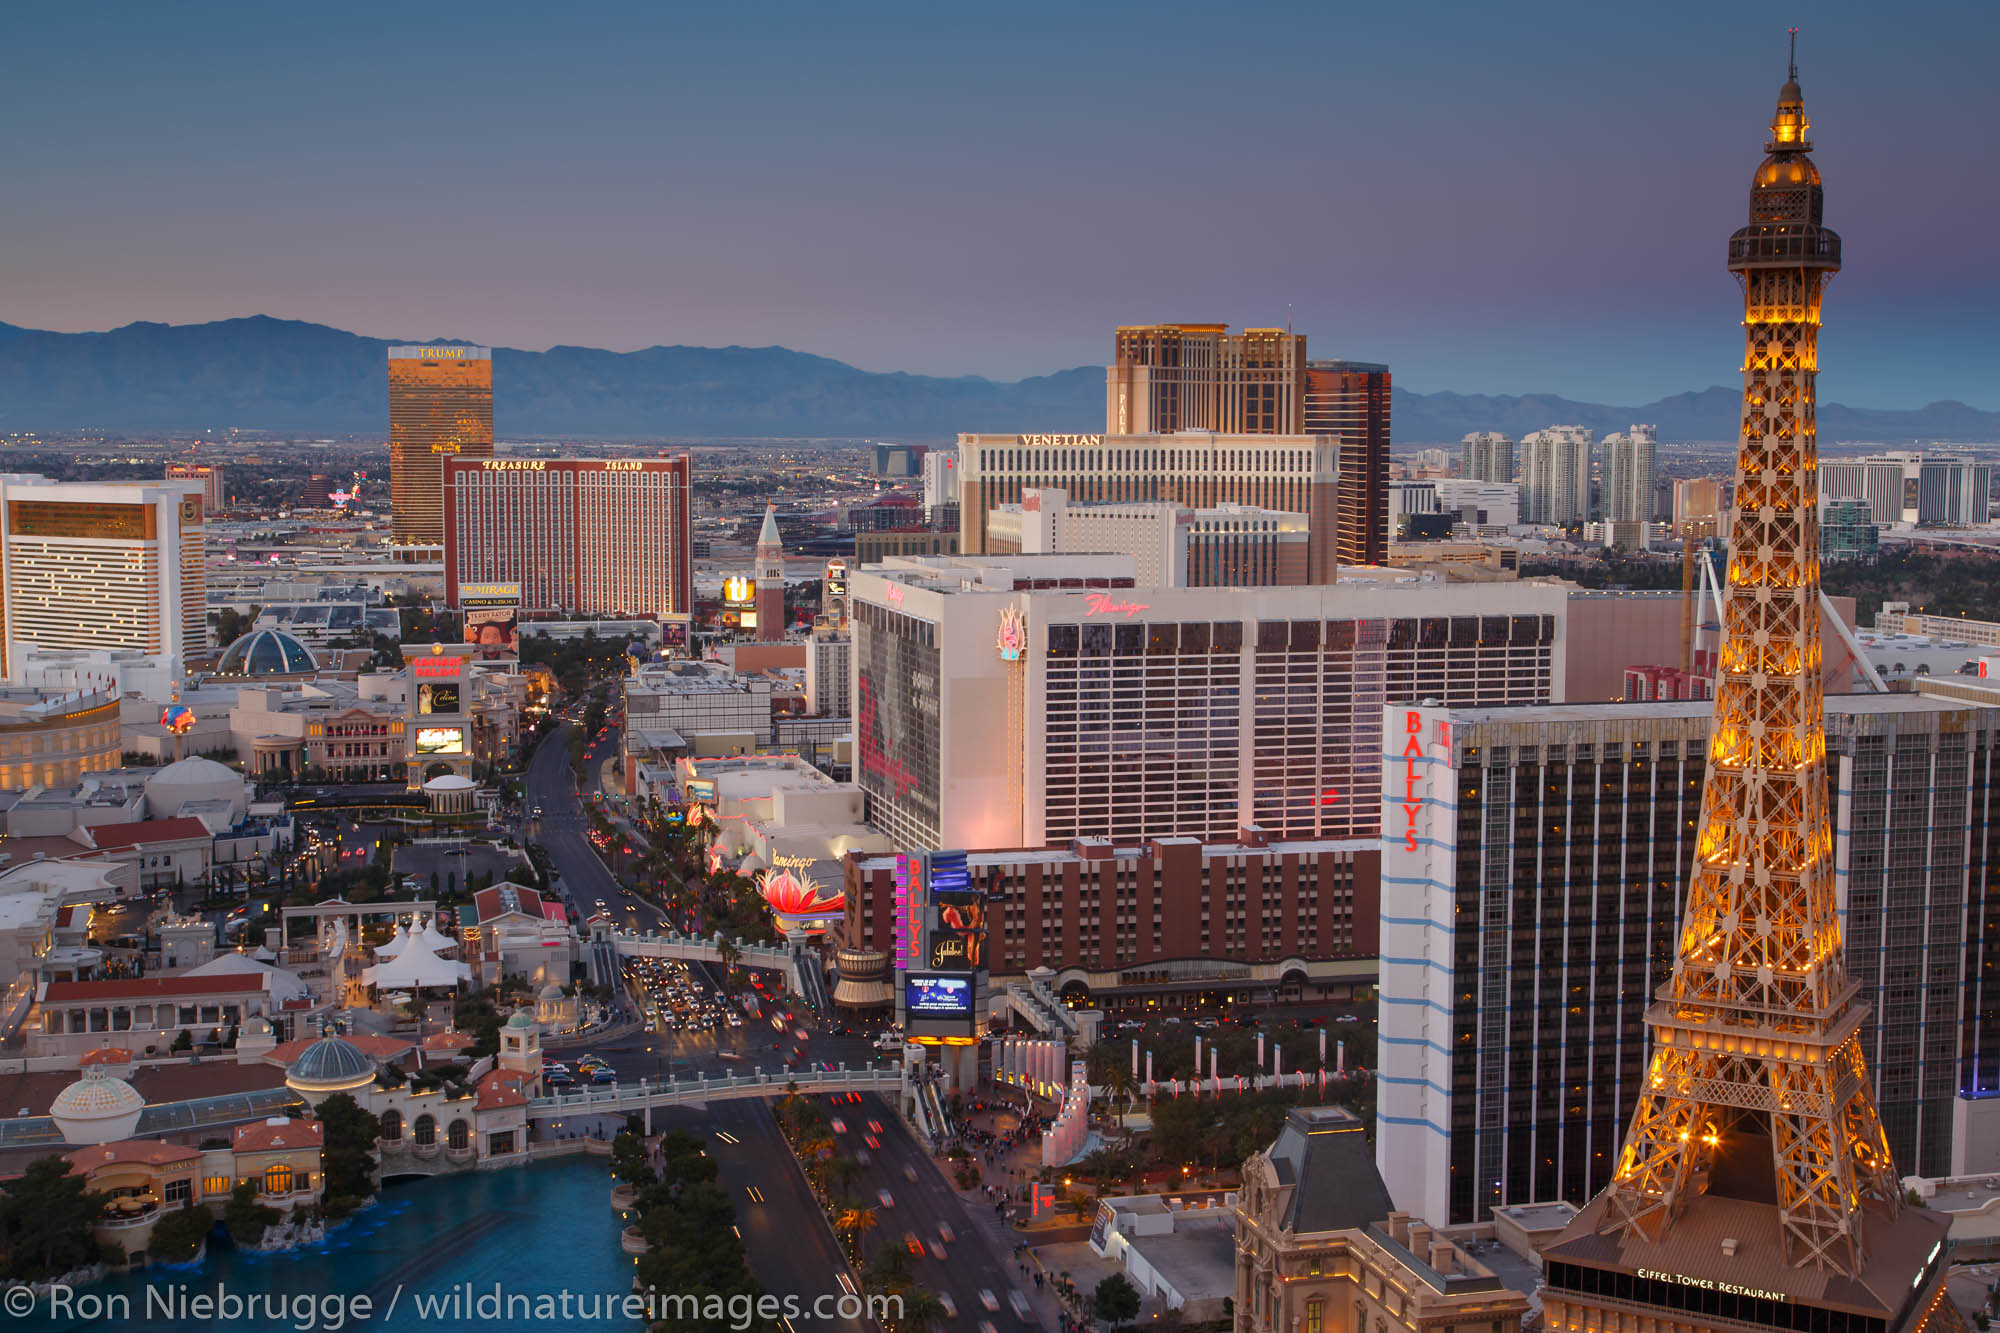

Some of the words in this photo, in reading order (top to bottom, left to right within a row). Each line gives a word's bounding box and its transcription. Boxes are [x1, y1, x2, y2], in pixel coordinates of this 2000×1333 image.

[418, 348, 464, 358] TRUMP
[1022, 434, 1101, 446] VENETIAN
[482, 461, 546, 471] TREASURE
[605, 461, 643, 471] ISLAND
[474, 584, 519, 596] MIRAGE
[412, 656, 463, 667] CAESARS
[416, 667, 460, 677] PALACE
[1638, 1268, 1674, 1283] EIFFEL
[1676, 1274, 1714, 1290] TOWER
[1718, 1281, 1785, 1302] RESTAURANT
